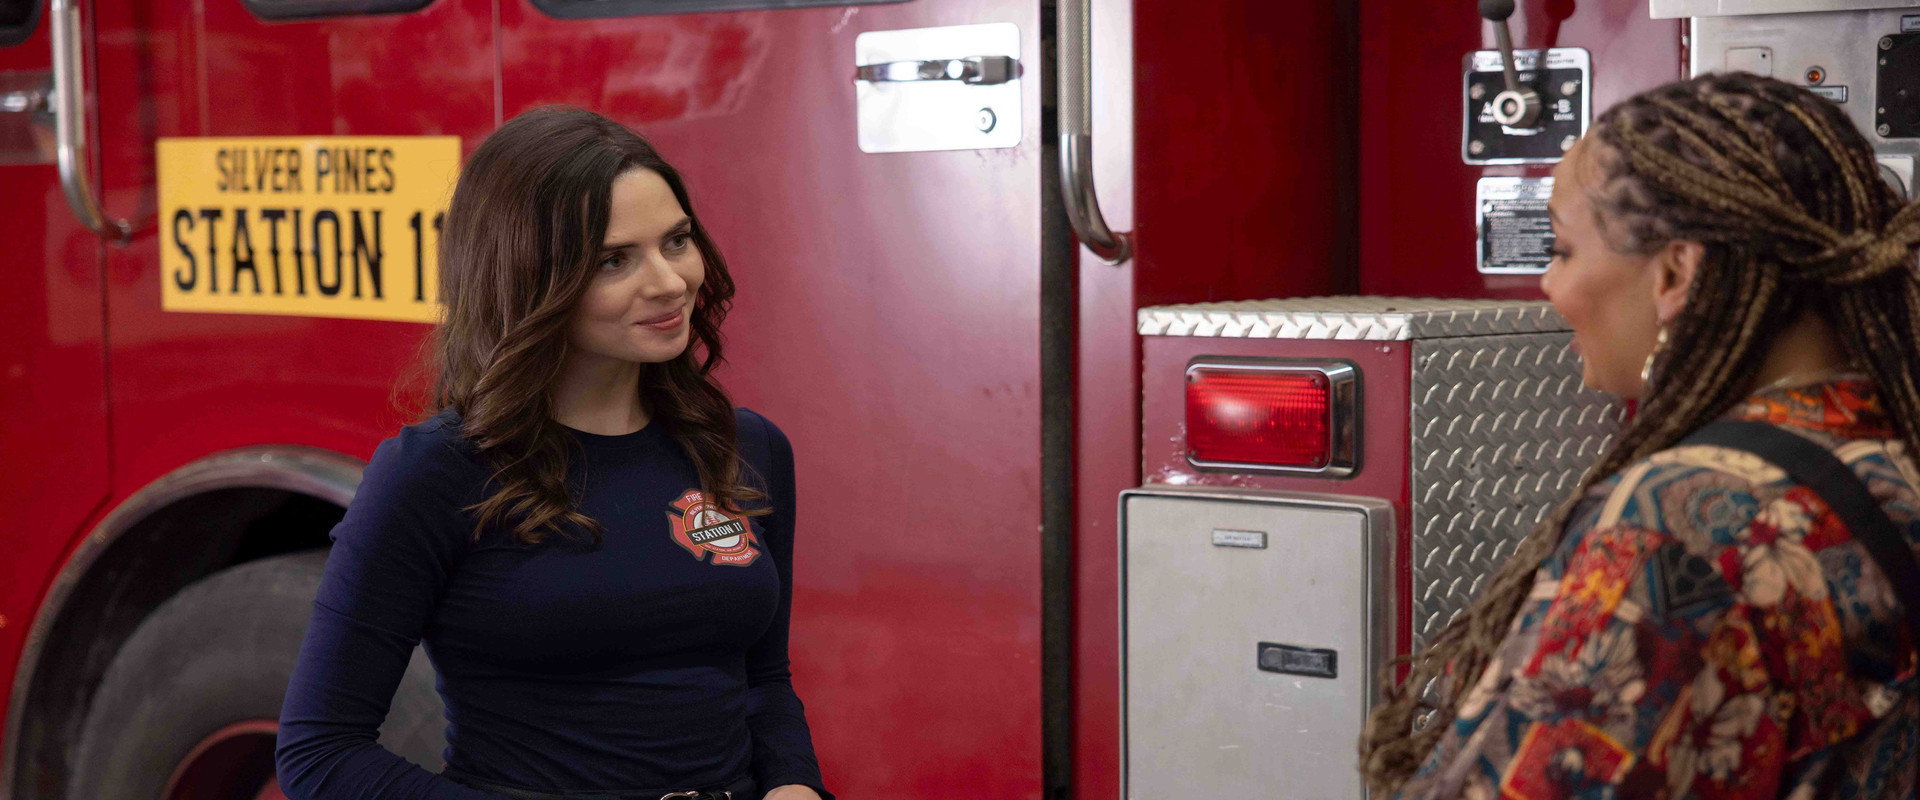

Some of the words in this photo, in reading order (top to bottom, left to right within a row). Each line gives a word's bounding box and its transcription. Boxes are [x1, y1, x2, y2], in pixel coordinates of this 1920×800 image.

[216, 148, 301, 192] SILVER
[315, 148, 394, 193] PINES
[173, 207, 383, 299] STATION
[685, 492, 704, 503] FIRE
[691, 525, 733, 542] STATION
[733, 522, 743, 532] 11
[721, 549, 754, 562] DEPARTMENT
